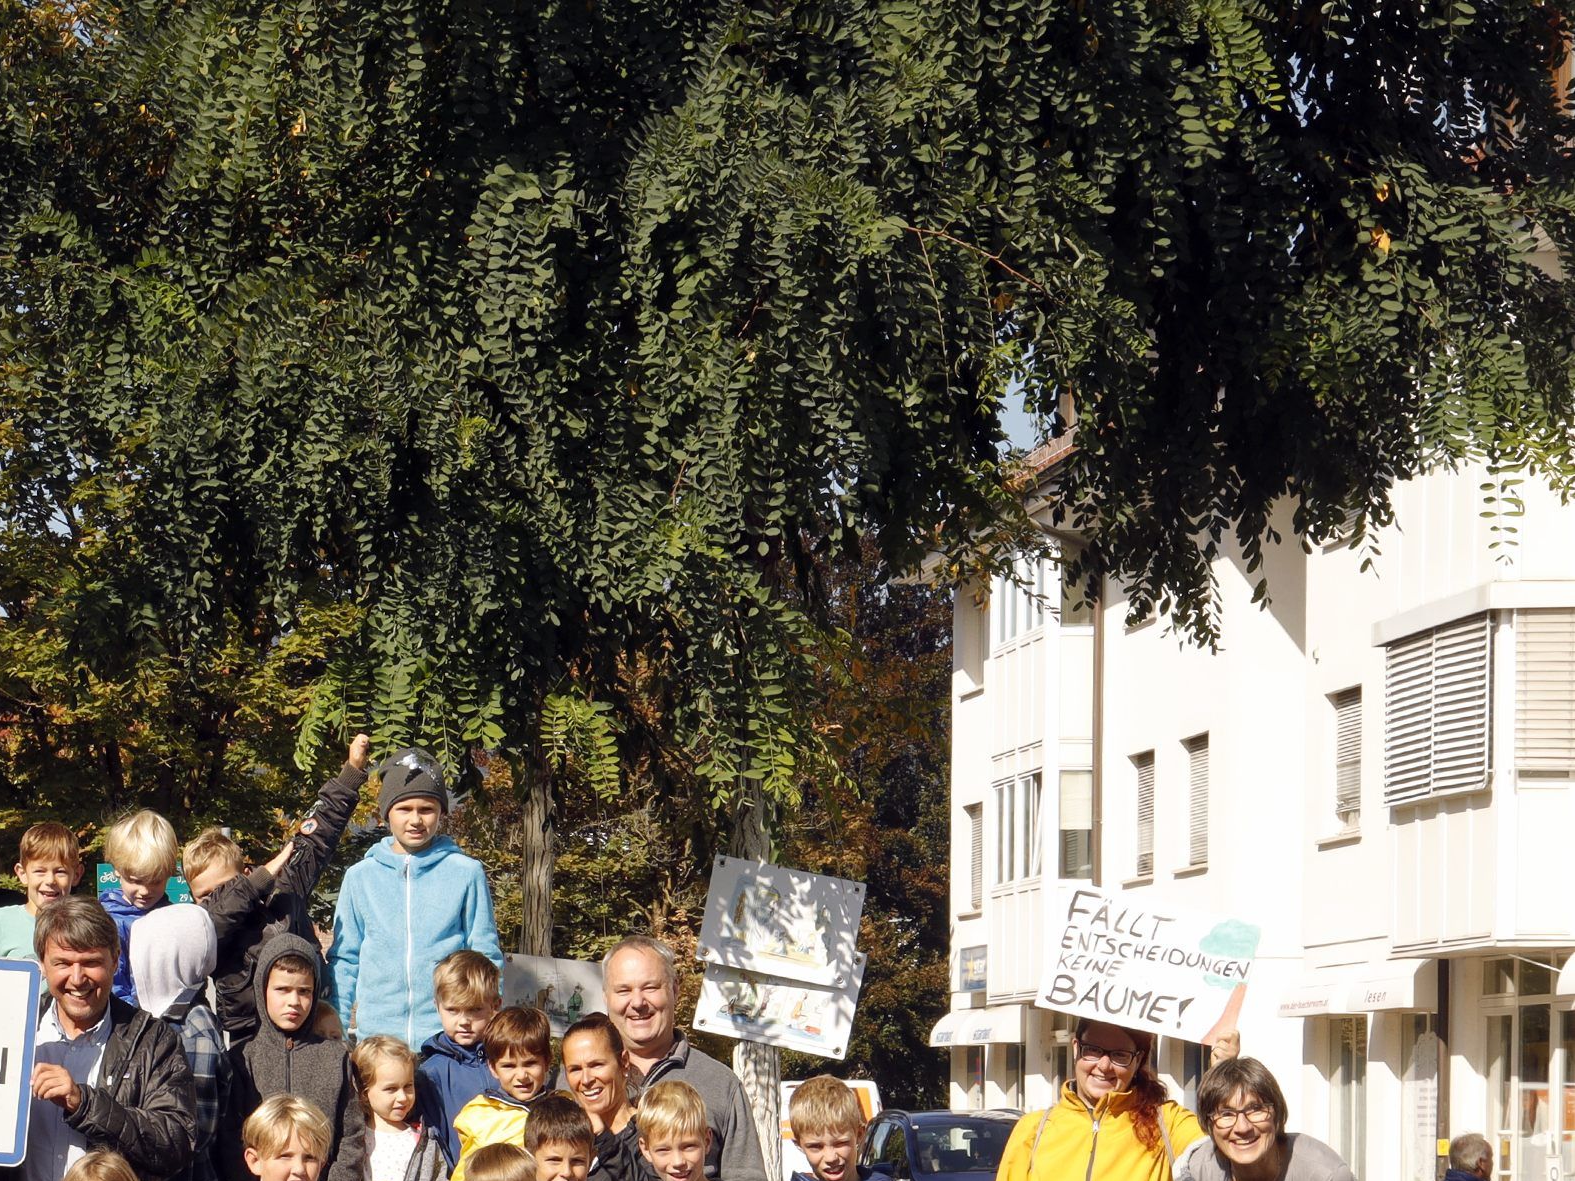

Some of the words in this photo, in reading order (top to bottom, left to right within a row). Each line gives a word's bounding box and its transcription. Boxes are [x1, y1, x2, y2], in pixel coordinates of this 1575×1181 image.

[1067, 890, 1176, 941] FÄLLT
[1057, 951, 1125, 978] KEINE
[1061, 925, 1251, 980] ENTSCHEIDUNGEN
[1045, 973, 1195, 1029] BÄUME!
[1363, 989, 1387, 1004] lesen
